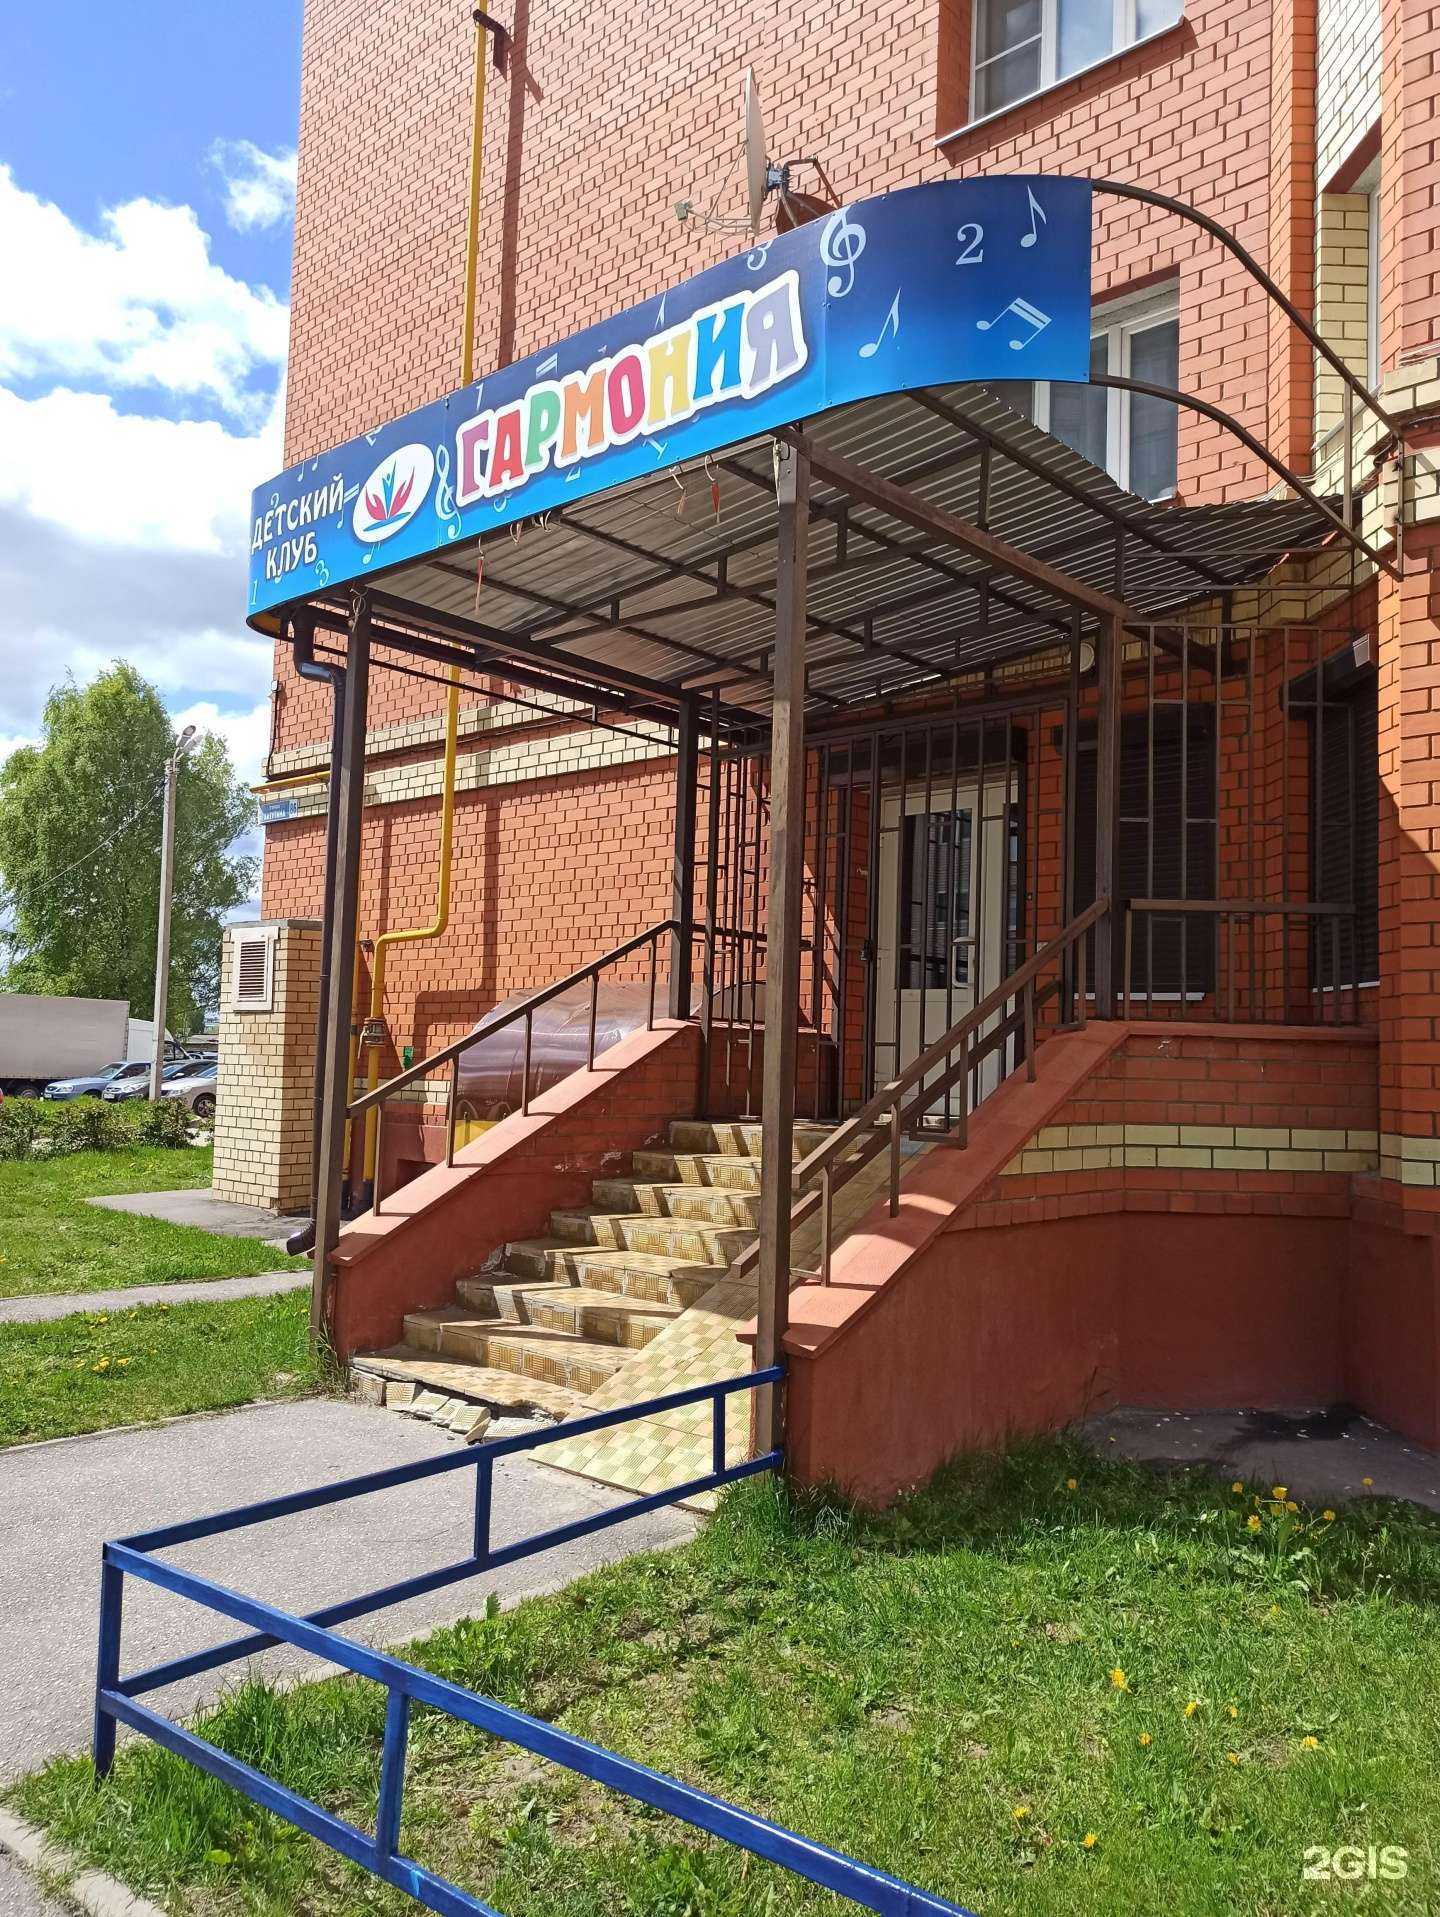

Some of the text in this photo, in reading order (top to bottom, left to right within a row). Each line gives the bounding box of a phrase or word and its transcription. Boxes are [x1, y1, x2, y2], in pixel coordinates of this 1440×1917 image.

[955, 222, 984, 265] 2
[458, 274, 806, 504] ГАРМОНИЯ
[251, 472, 344, 556] ДЕТСКИЙ
[265, 531, 318, 580] КЛУБ
